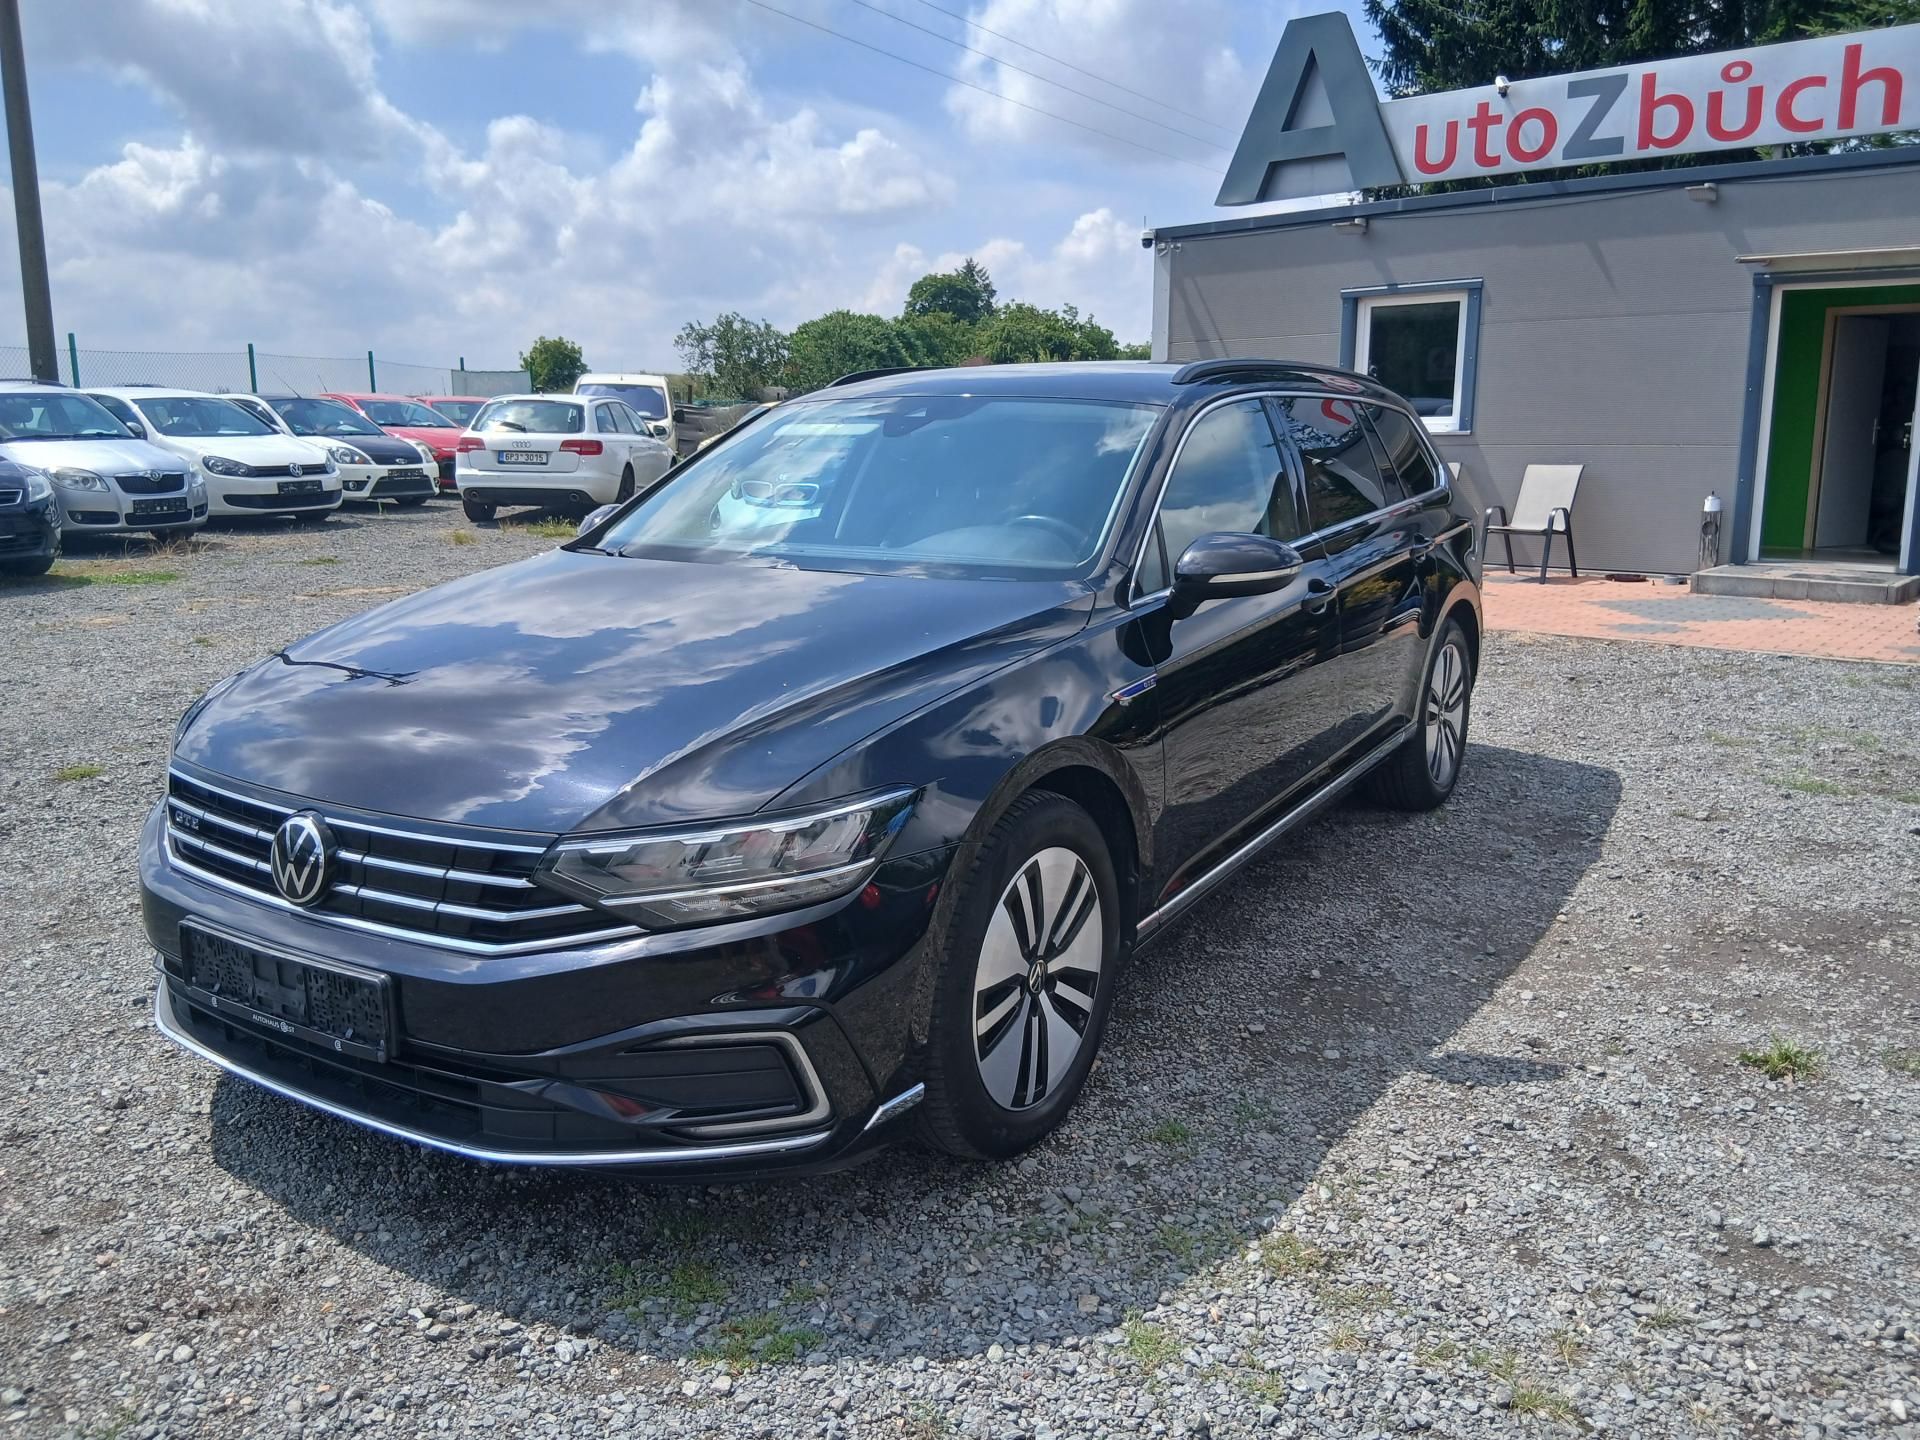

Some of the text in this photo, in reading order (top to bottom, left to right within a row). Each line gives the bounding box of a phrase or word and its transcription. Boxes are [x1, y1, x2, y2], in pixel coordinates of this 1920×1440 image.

[505, 453, 544, 462] 6P3 3015
[175, 810, 200, 831] GTE
